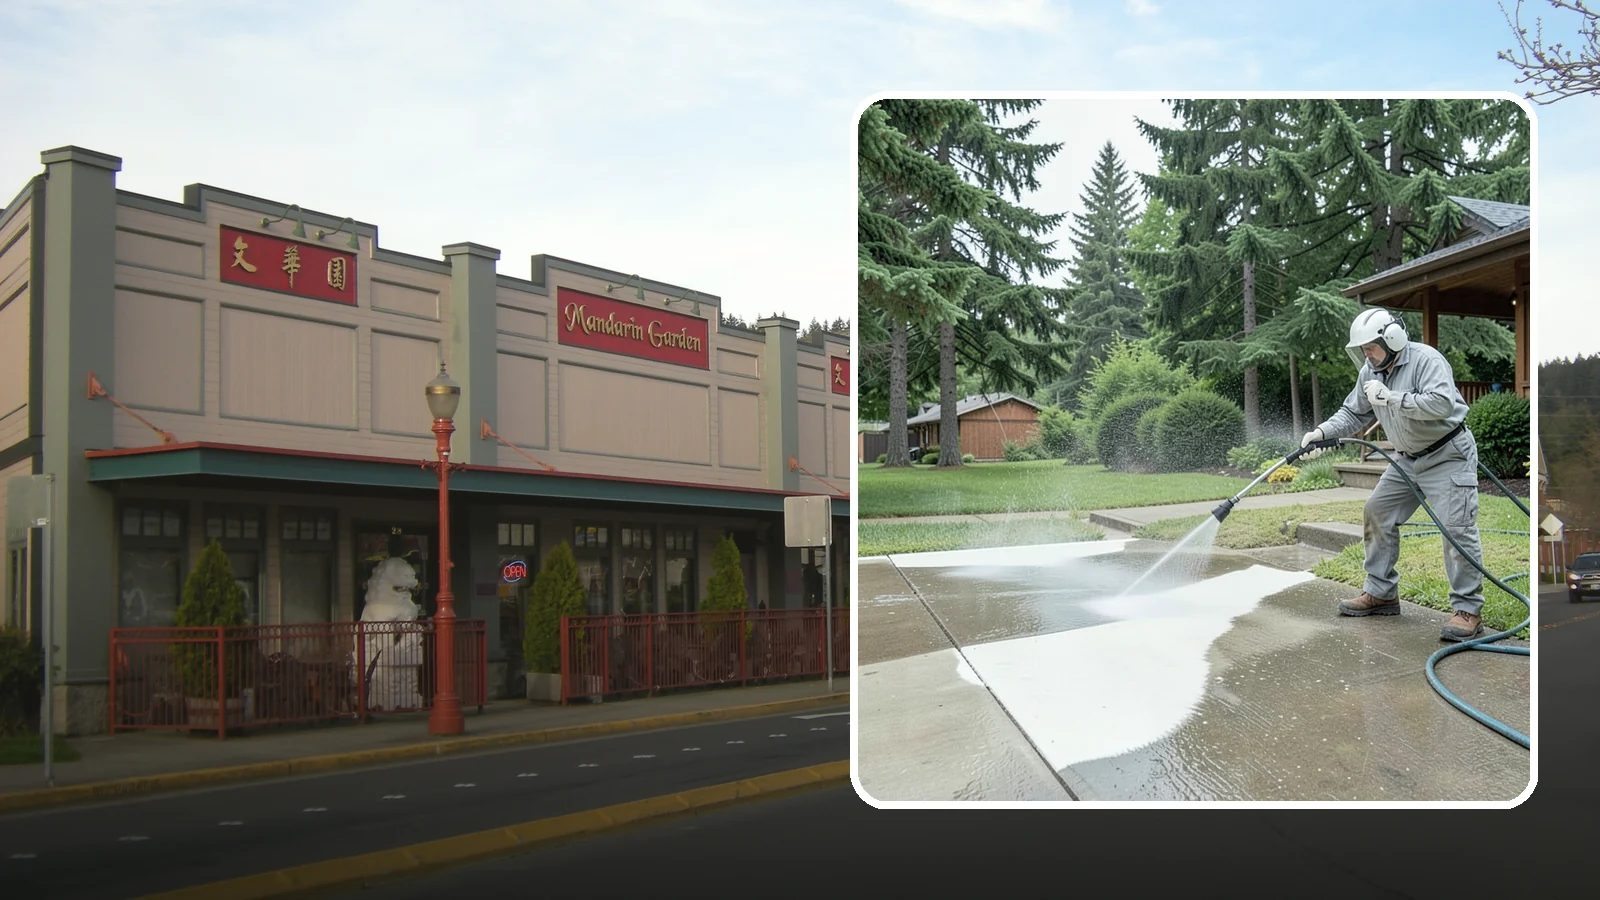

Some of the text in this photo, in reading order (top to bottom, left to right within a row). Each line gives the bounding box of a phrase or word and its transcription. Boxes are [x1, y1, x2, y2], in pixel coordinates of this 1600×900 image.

[231, 235, 346, 290] 文華園
[564, 302, 701, 352] Mandarin Garden
[503, 565, 526, 578] OPEN
